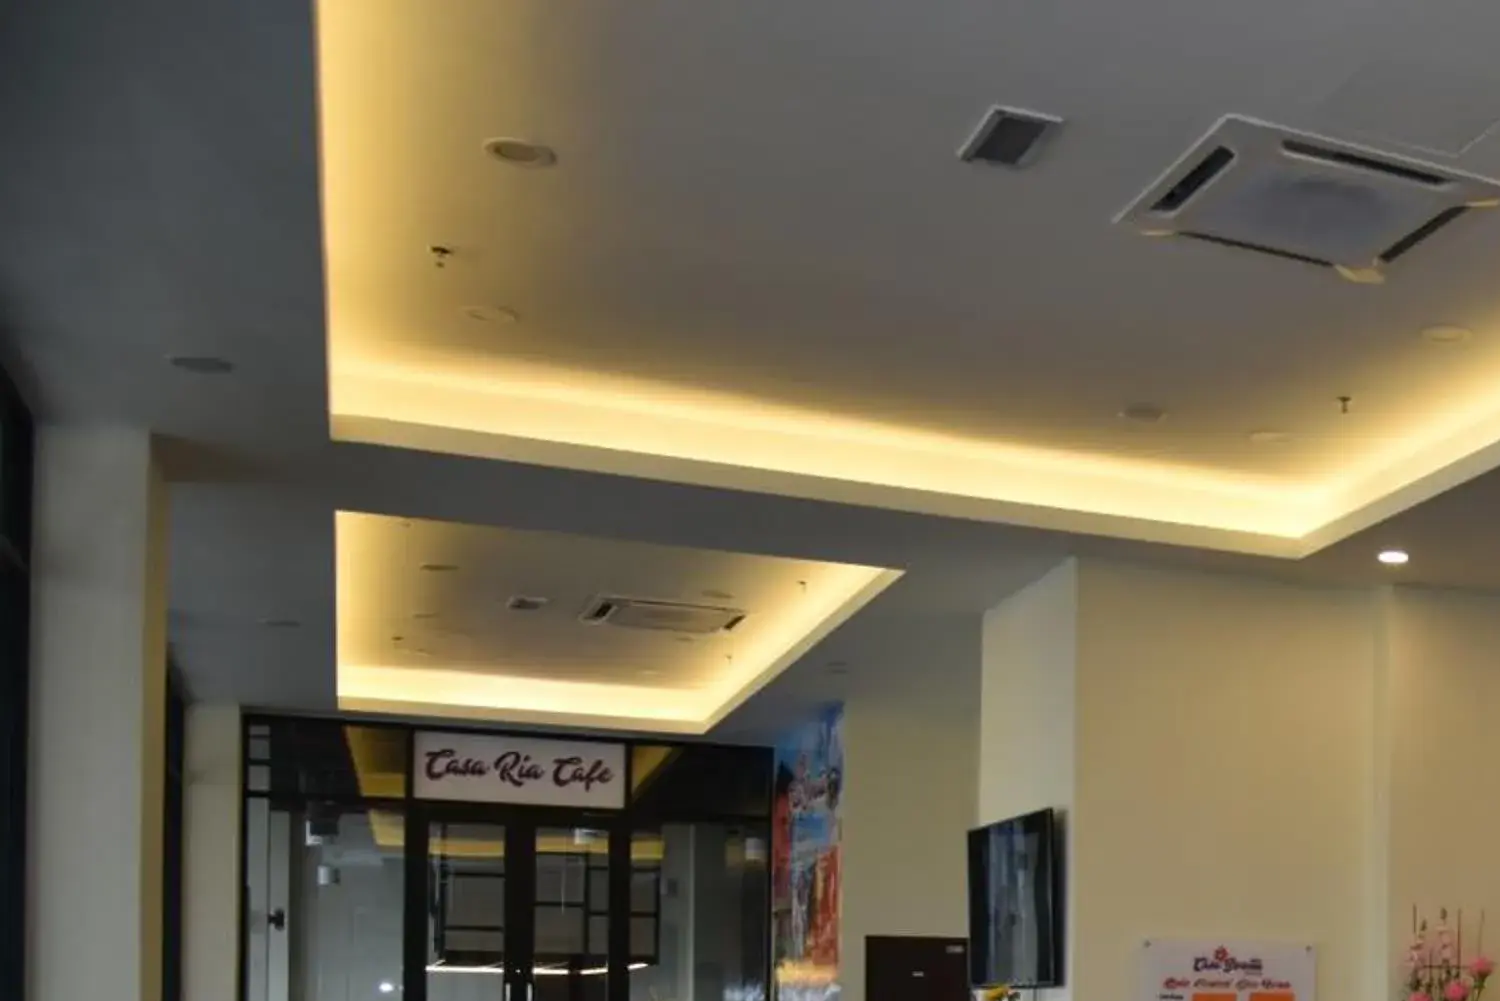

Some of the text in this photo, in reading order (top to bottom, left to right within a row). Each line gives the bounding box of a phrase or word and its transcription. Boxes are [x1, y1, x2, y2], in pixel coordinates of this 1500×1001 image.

[425, 749, 614, 792] Casa Ria Cafe
